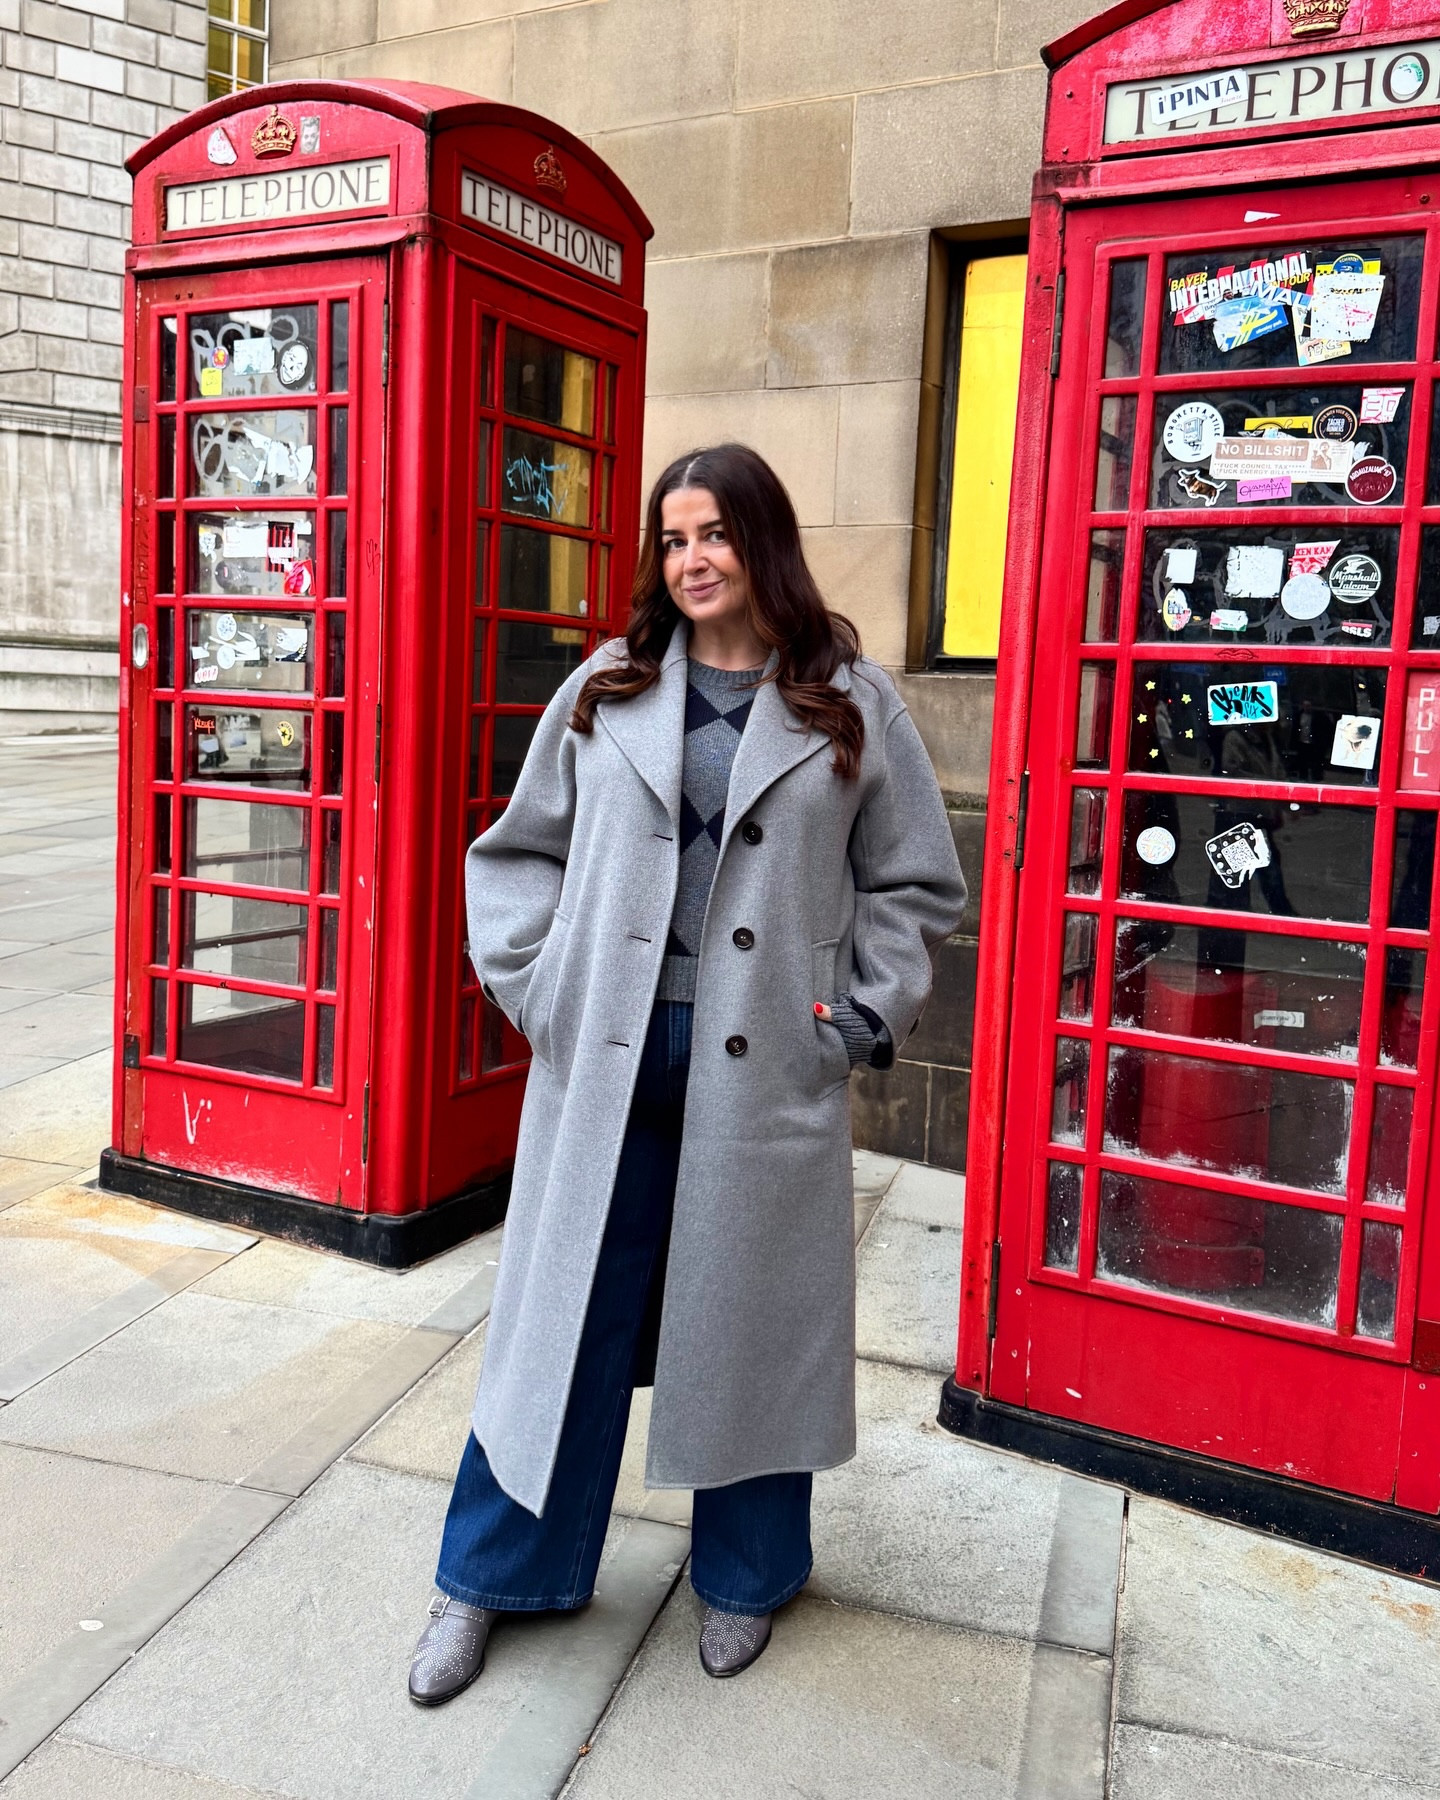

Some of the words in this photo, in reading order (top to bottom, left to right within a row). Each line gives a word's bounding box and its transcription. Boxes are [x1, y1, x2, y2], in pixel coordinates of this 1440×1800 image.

[176, 164, 384, 225] TELEPHONE
[466, 176, 617, 280] TELEPHONE
[1171, 272, 1208, 291] BAYER
[1283, 271, 1311, 288] TOUR
[1167, 406, 1208, 444] BORGHETTA
[1220, 444, 1240, 455] NO
[1244, 444, 1305, 457] BILLSHIT
[1332, 570, 1377, 582] Marshall
[1413, 688, 1436, 777] PULL
